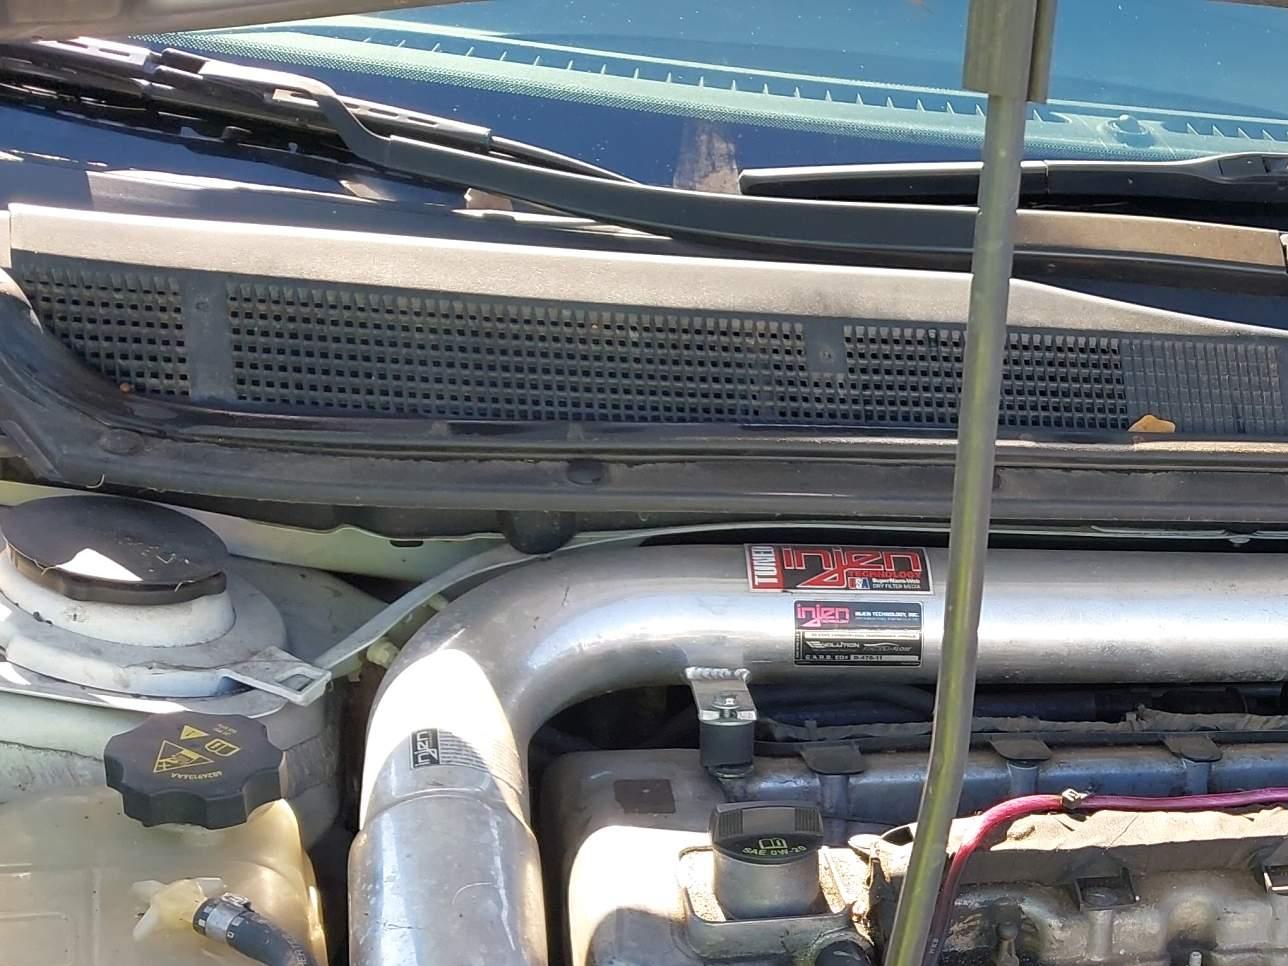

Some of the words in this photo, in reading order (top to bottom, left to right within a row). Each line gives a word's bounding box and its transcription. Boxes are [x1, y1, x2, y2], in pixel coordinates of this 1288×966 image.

[751, 546, 778, 586] TUNED
[848, 577, 870, 590] USA
[742, 847, 767, 856] SAE
